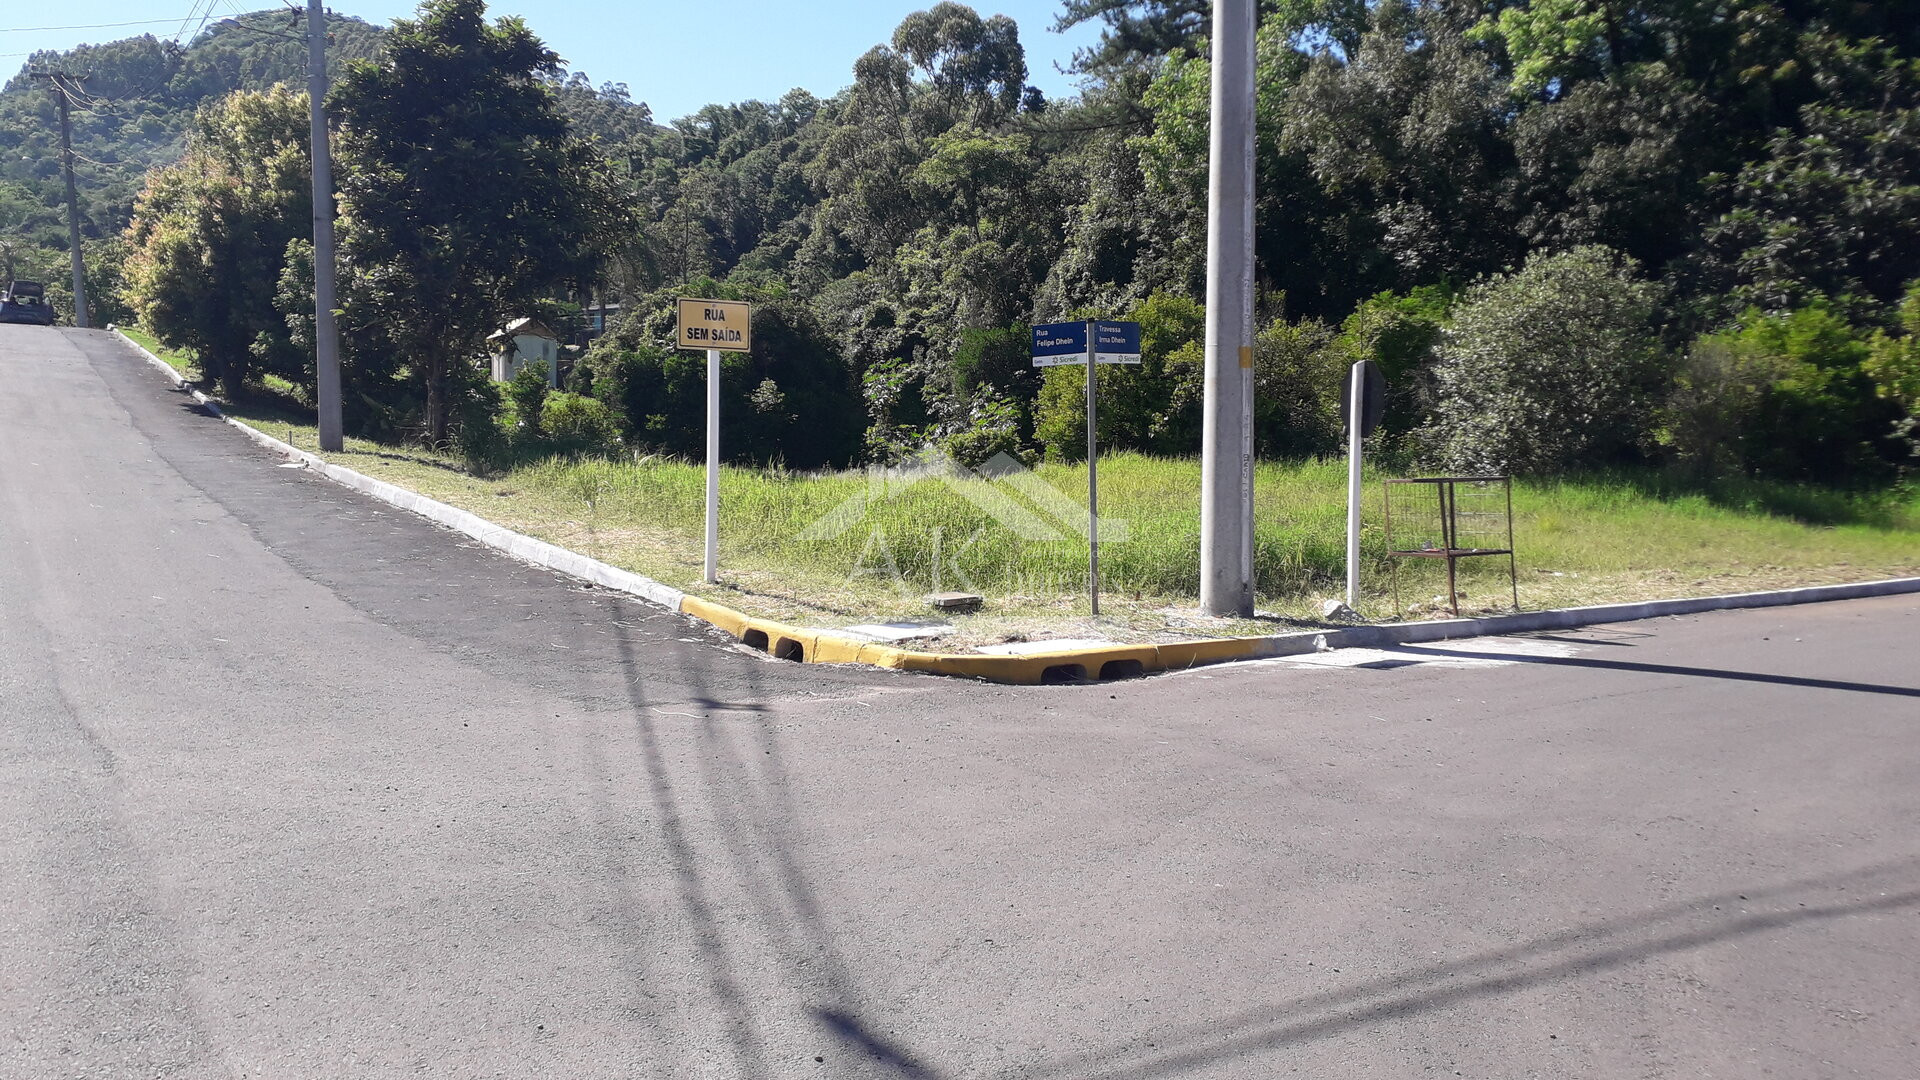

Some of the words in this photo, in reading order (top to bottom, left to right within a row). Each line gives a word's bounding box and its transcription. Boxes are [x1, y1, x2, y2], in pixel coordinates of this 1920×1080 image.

[704, 309, 725, 321] RUA
[1099, 325, 1121, 333] Travessa
[687, 327, 708, 340] SEM
[711, 327, 741, 342] SAÍDA
[1036, 339, 1055, 347] Felipe
[1055, 337, 1074, 345] Dhein
[1111, 336, 1126, 344] Dhein
